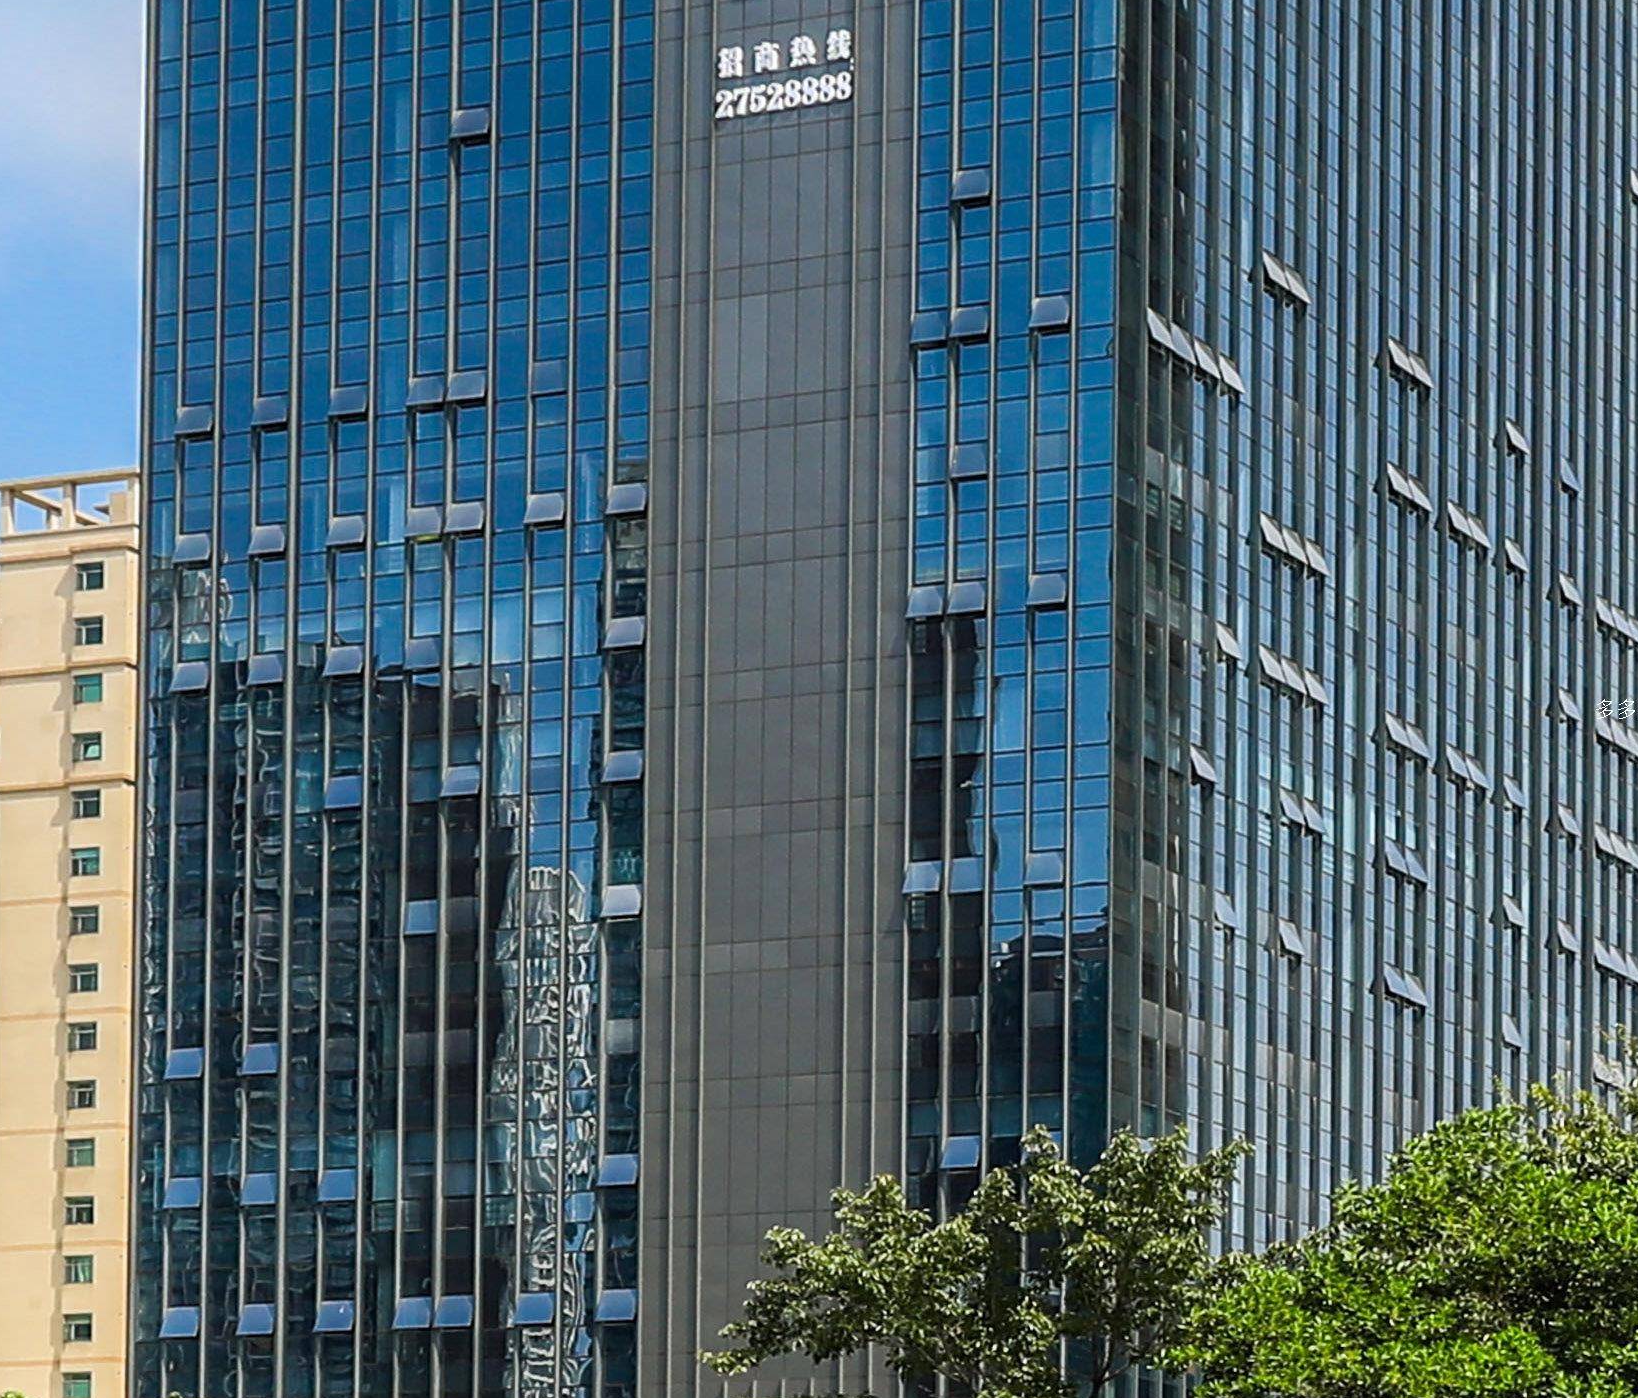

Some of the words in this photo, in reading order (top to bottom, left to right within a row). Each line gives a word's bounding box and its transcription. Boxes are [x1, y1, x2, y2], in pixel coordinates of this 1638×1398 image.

[717, 29, 852, 79] 招商热线
[714, 71, 853, 119] 27528888
